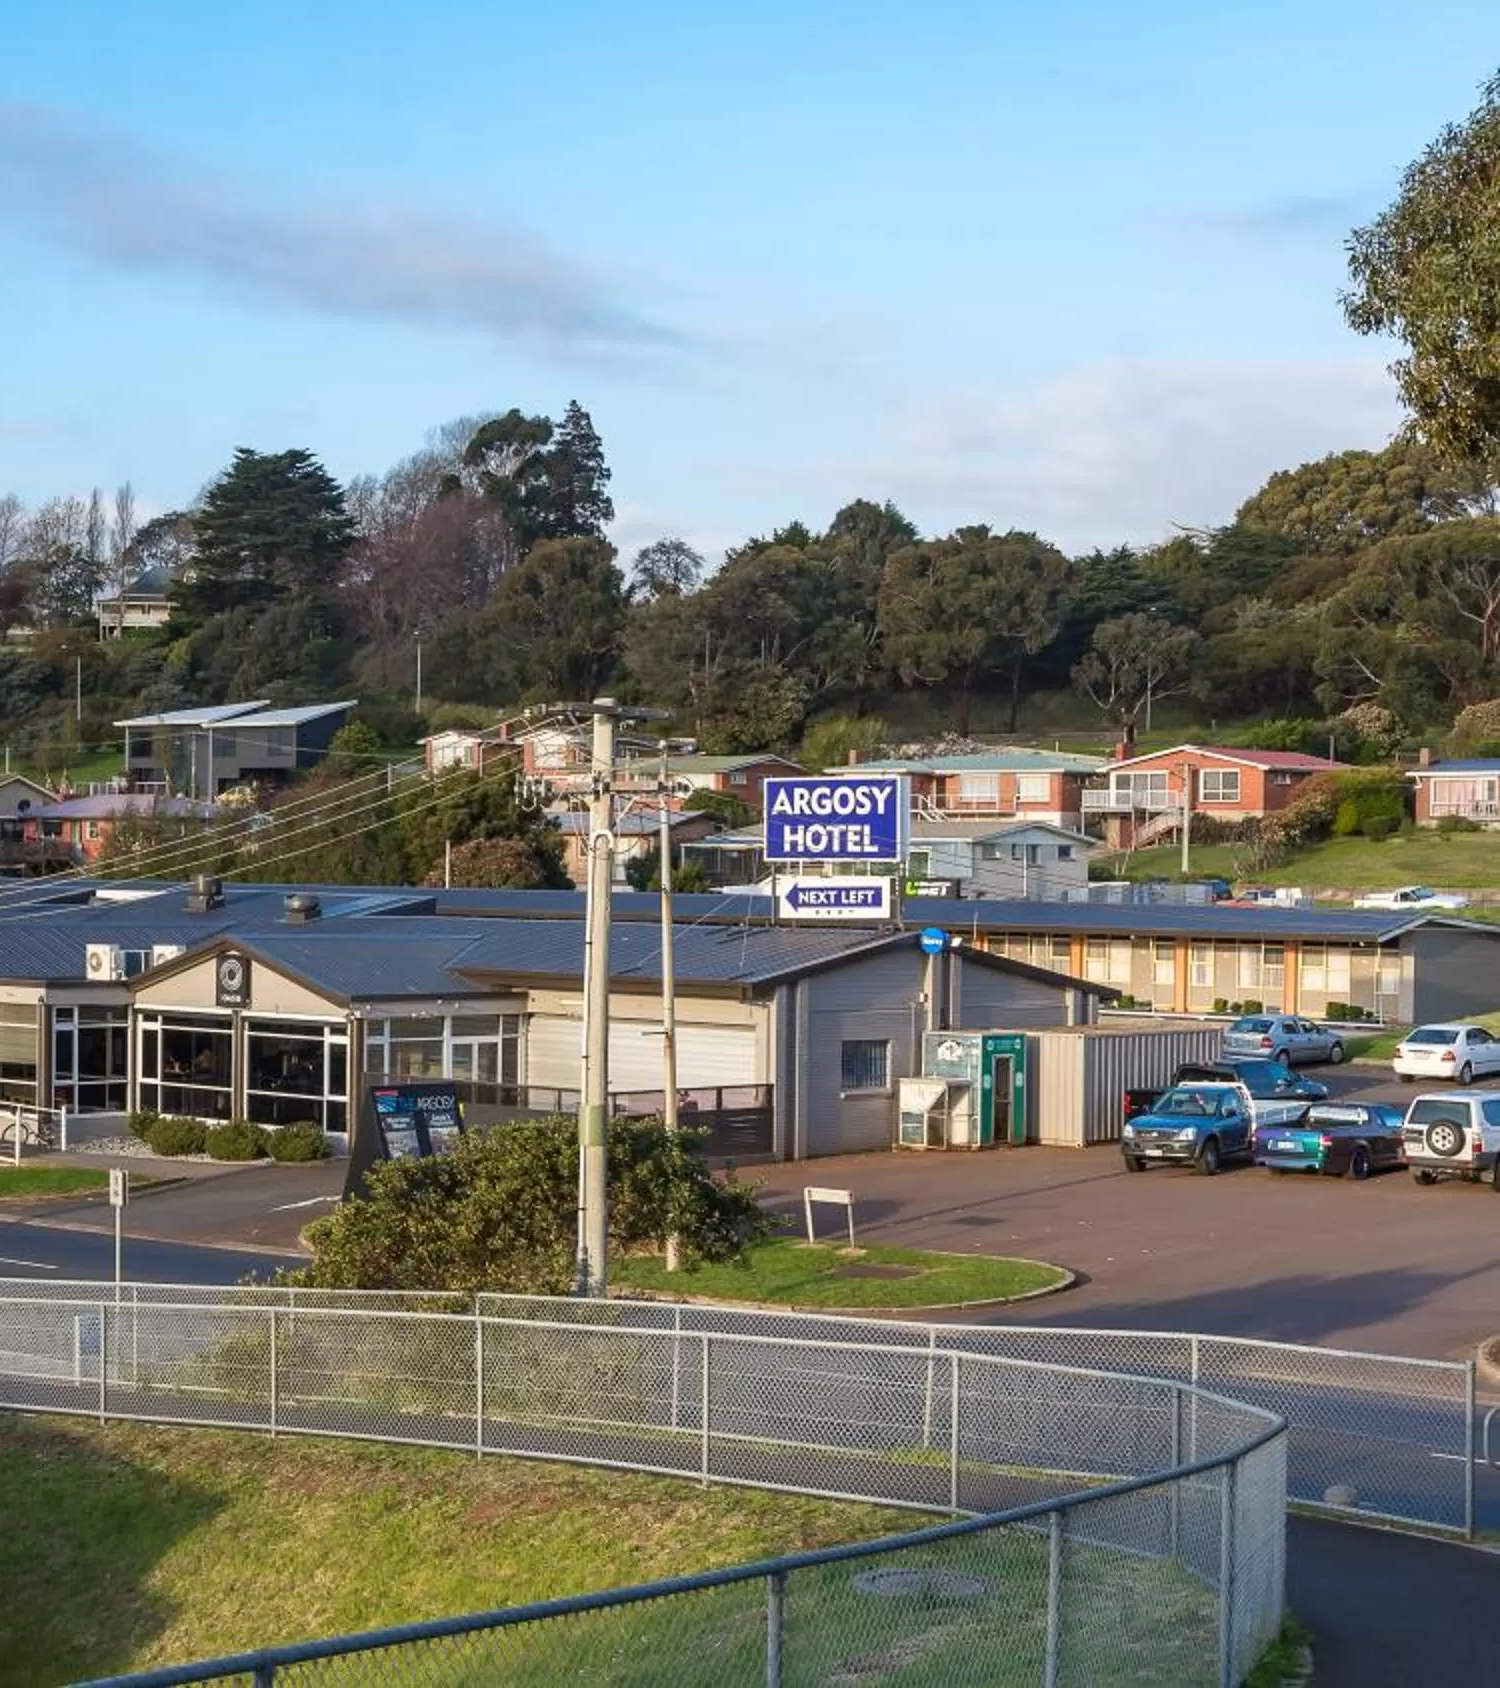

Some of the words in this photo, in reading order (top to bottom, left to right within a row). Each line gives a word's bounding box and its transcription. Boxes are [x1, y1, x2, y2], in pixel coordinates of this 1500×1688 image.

[771, 785, 893, 815] ARGOSY
[783, 824, 879, 853] HOTEL
[798, 890, 838, 904] NEXT
[841, 890, 875, 904] LEFT
